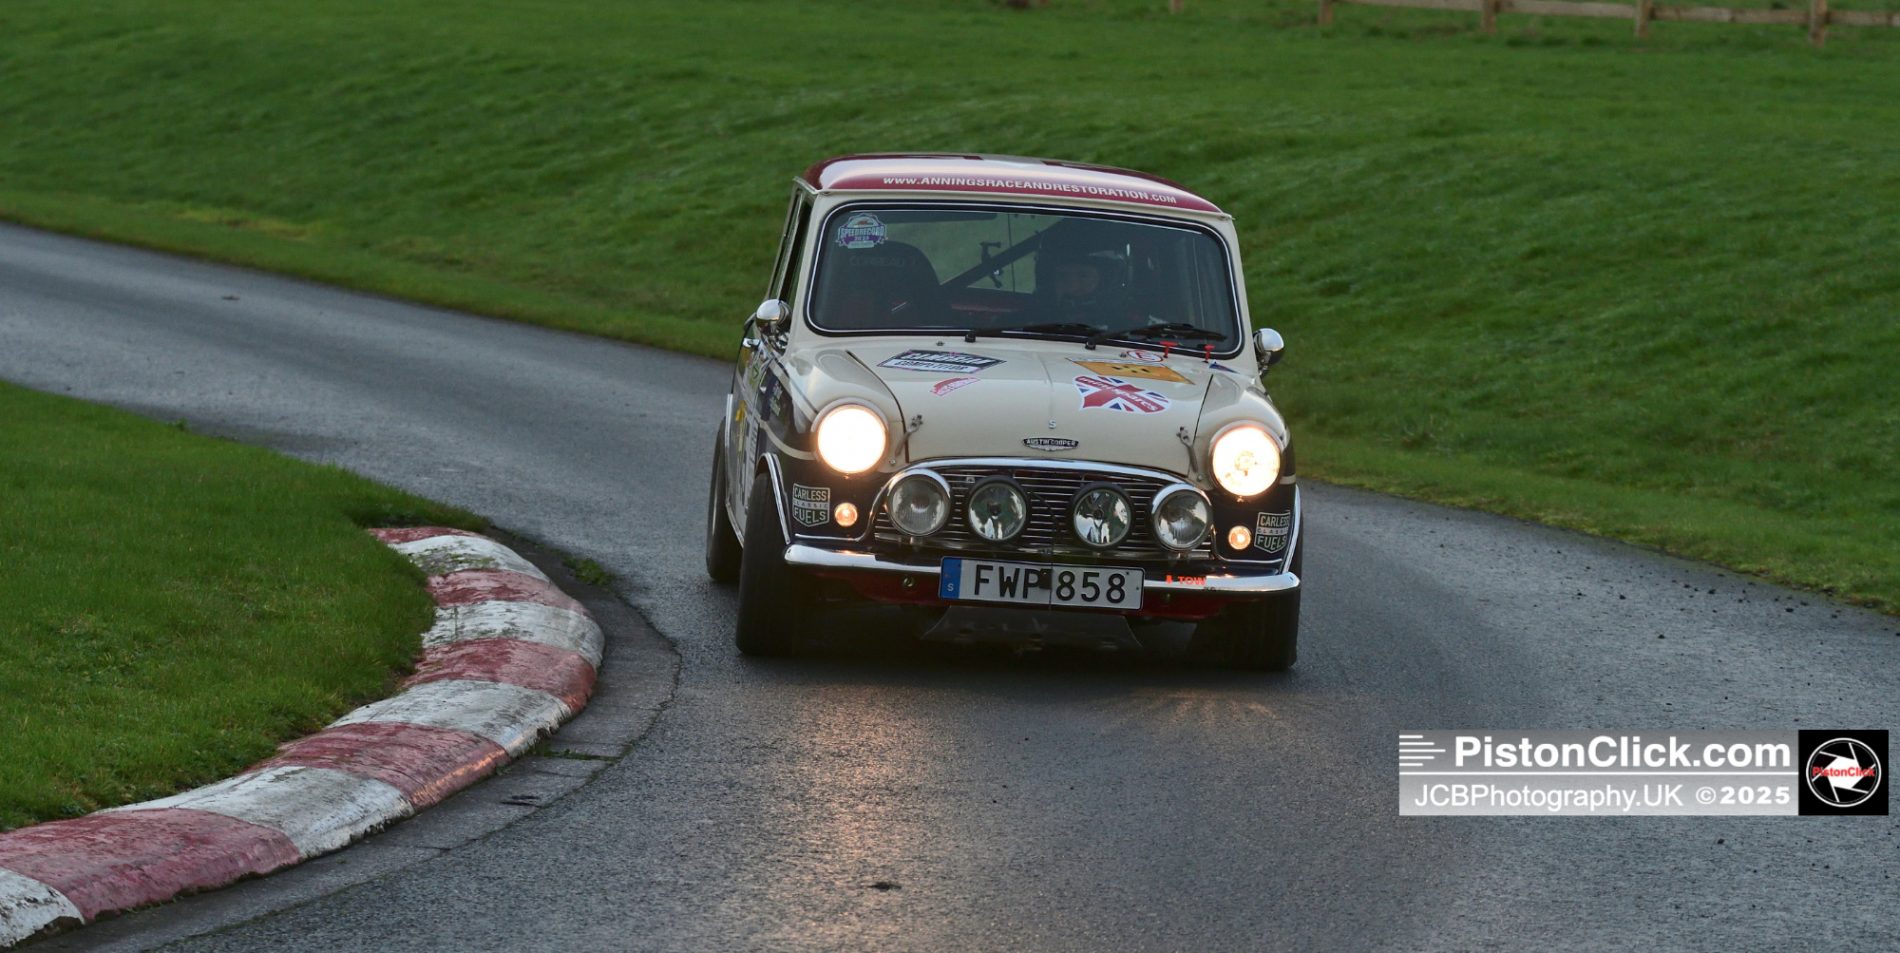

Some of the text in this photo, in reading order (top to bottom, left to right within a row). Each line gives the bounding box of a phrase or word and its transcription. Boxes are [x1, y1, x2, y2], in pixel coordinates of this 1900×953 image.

[882, 175, 1177, 204] www.ANNINGSRACEANDRESTORATION.COM
[1048, 419, 1057, 430] S
[793, 486, 828, 502] CARLESS
[794, 506, 827, 523] FUELS
[1257, 535, 1288, 551] FUELS
[946, 583, 954, 592] S
[973, 564, 1127, 604] FWP 858
[1177, 575, 1207, 586] TOW
